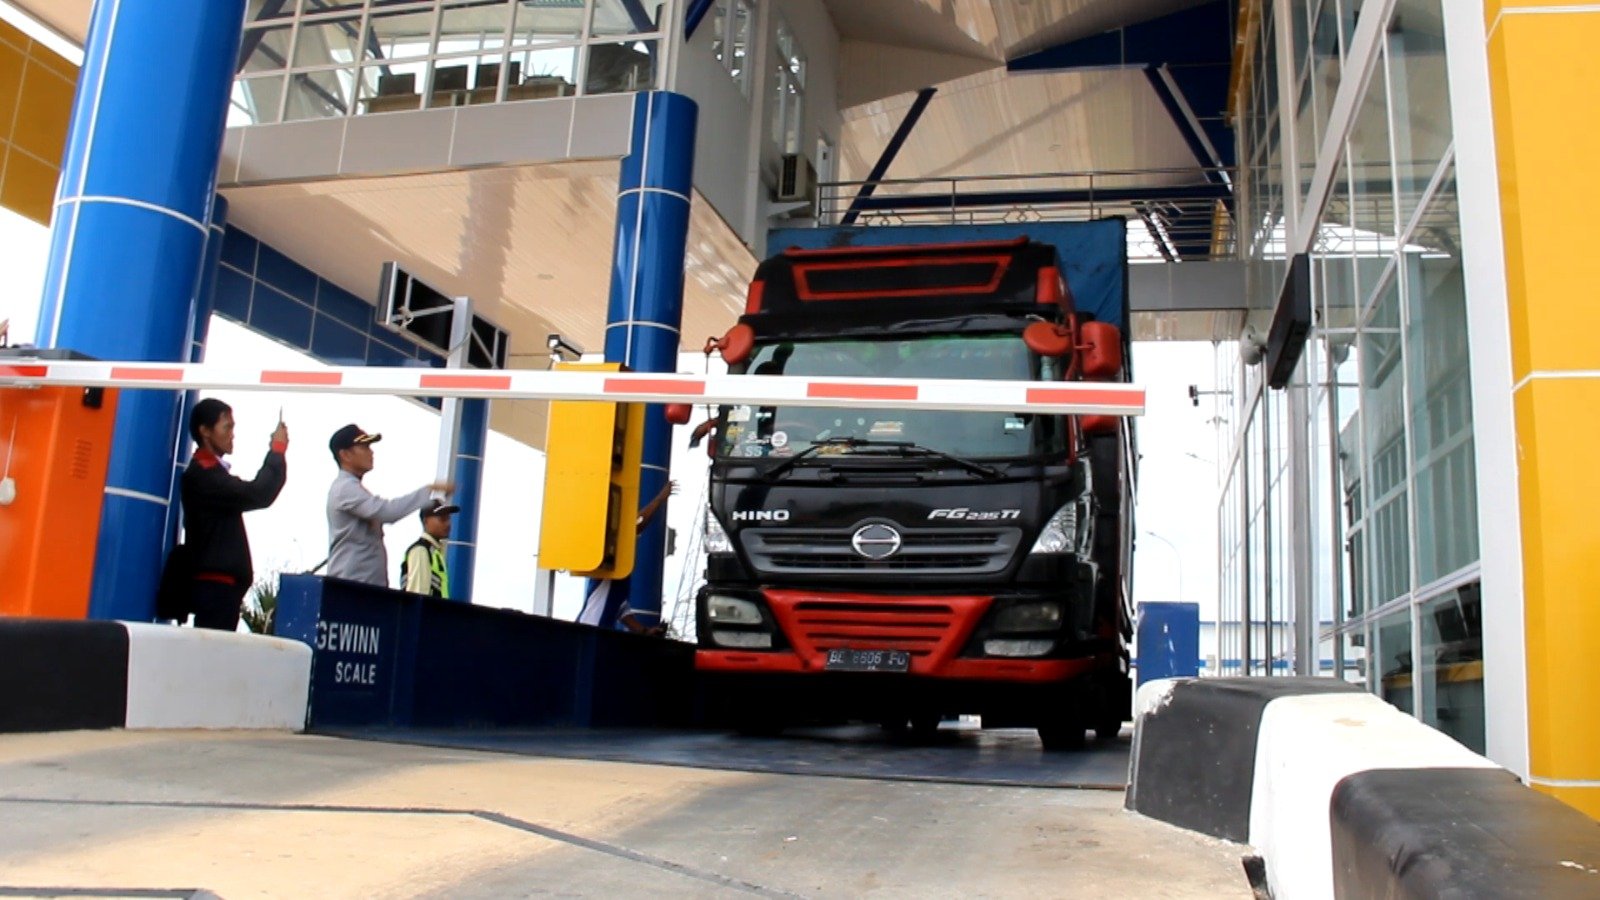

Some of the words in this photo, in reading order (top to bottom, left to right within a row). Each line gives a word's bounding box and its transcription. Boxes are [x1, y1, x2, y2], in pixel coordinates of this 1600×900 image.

[732, 509, 790, 521] HINO
[315, 620, 380, 655] GEWINN
[335, 661, 377, 684] SCALE
